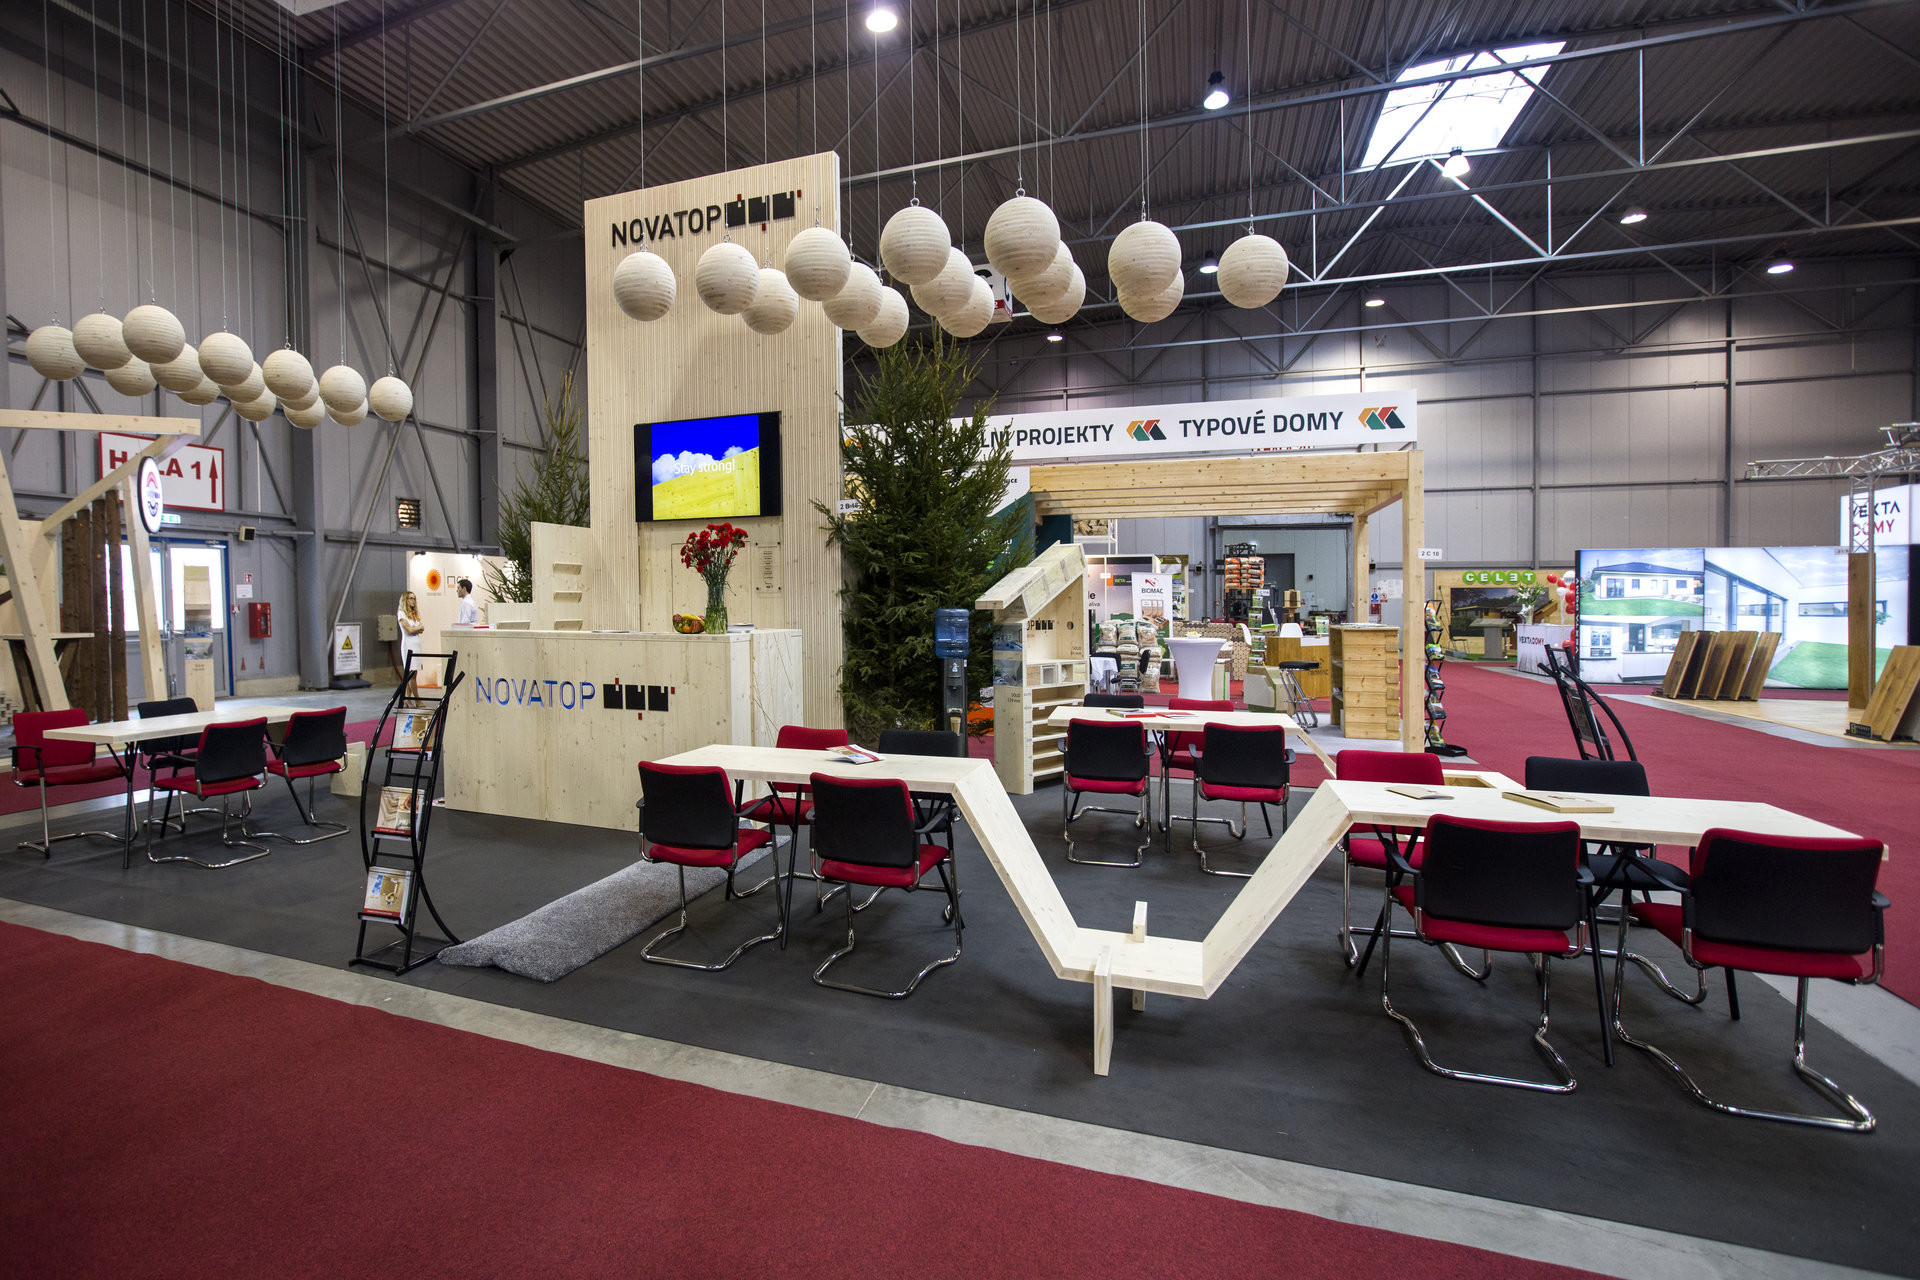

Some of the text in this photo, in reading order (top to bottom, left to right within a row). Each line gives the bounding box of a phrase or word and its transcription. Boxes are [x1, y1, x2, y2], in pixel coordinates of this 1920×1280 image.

[611, 205, 721, 248] NOVATOP
[1017, 424, 1114, 446] PROJEKTY
[1178, 410, 1344, 438] TYPOVÉ DOMY
[191, 461, 201, 480] 1
[674, 459, 736, 476] Stay strong!
[475, 677, 596, 710] NOVATOP
